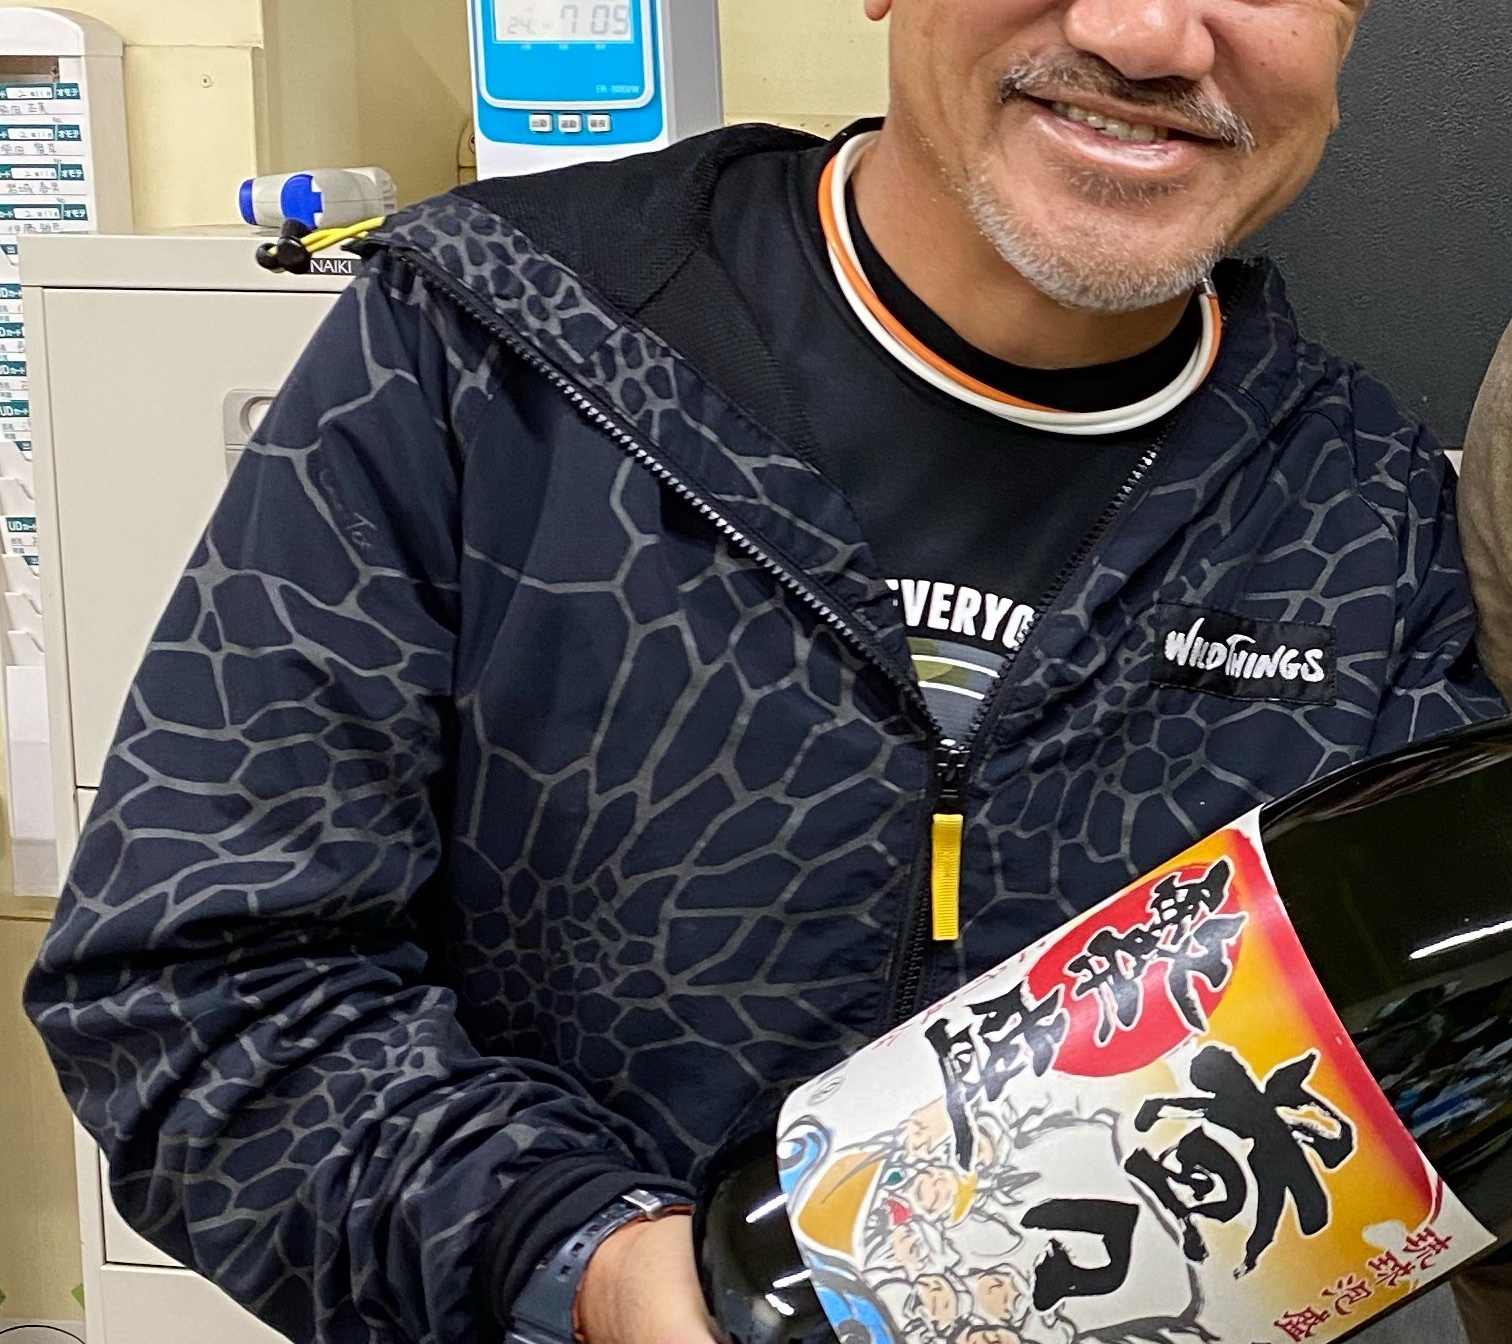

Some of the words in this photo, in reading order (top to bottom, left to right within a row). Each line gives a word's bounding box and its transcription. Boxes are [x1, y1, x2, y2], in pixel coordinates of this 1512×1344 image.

[310, 259, 352, 274] NAIKI
[1020, 1045, 1356, 1312] 益々
[1274, 1223, 1453, 1343] 琉球泡盛
